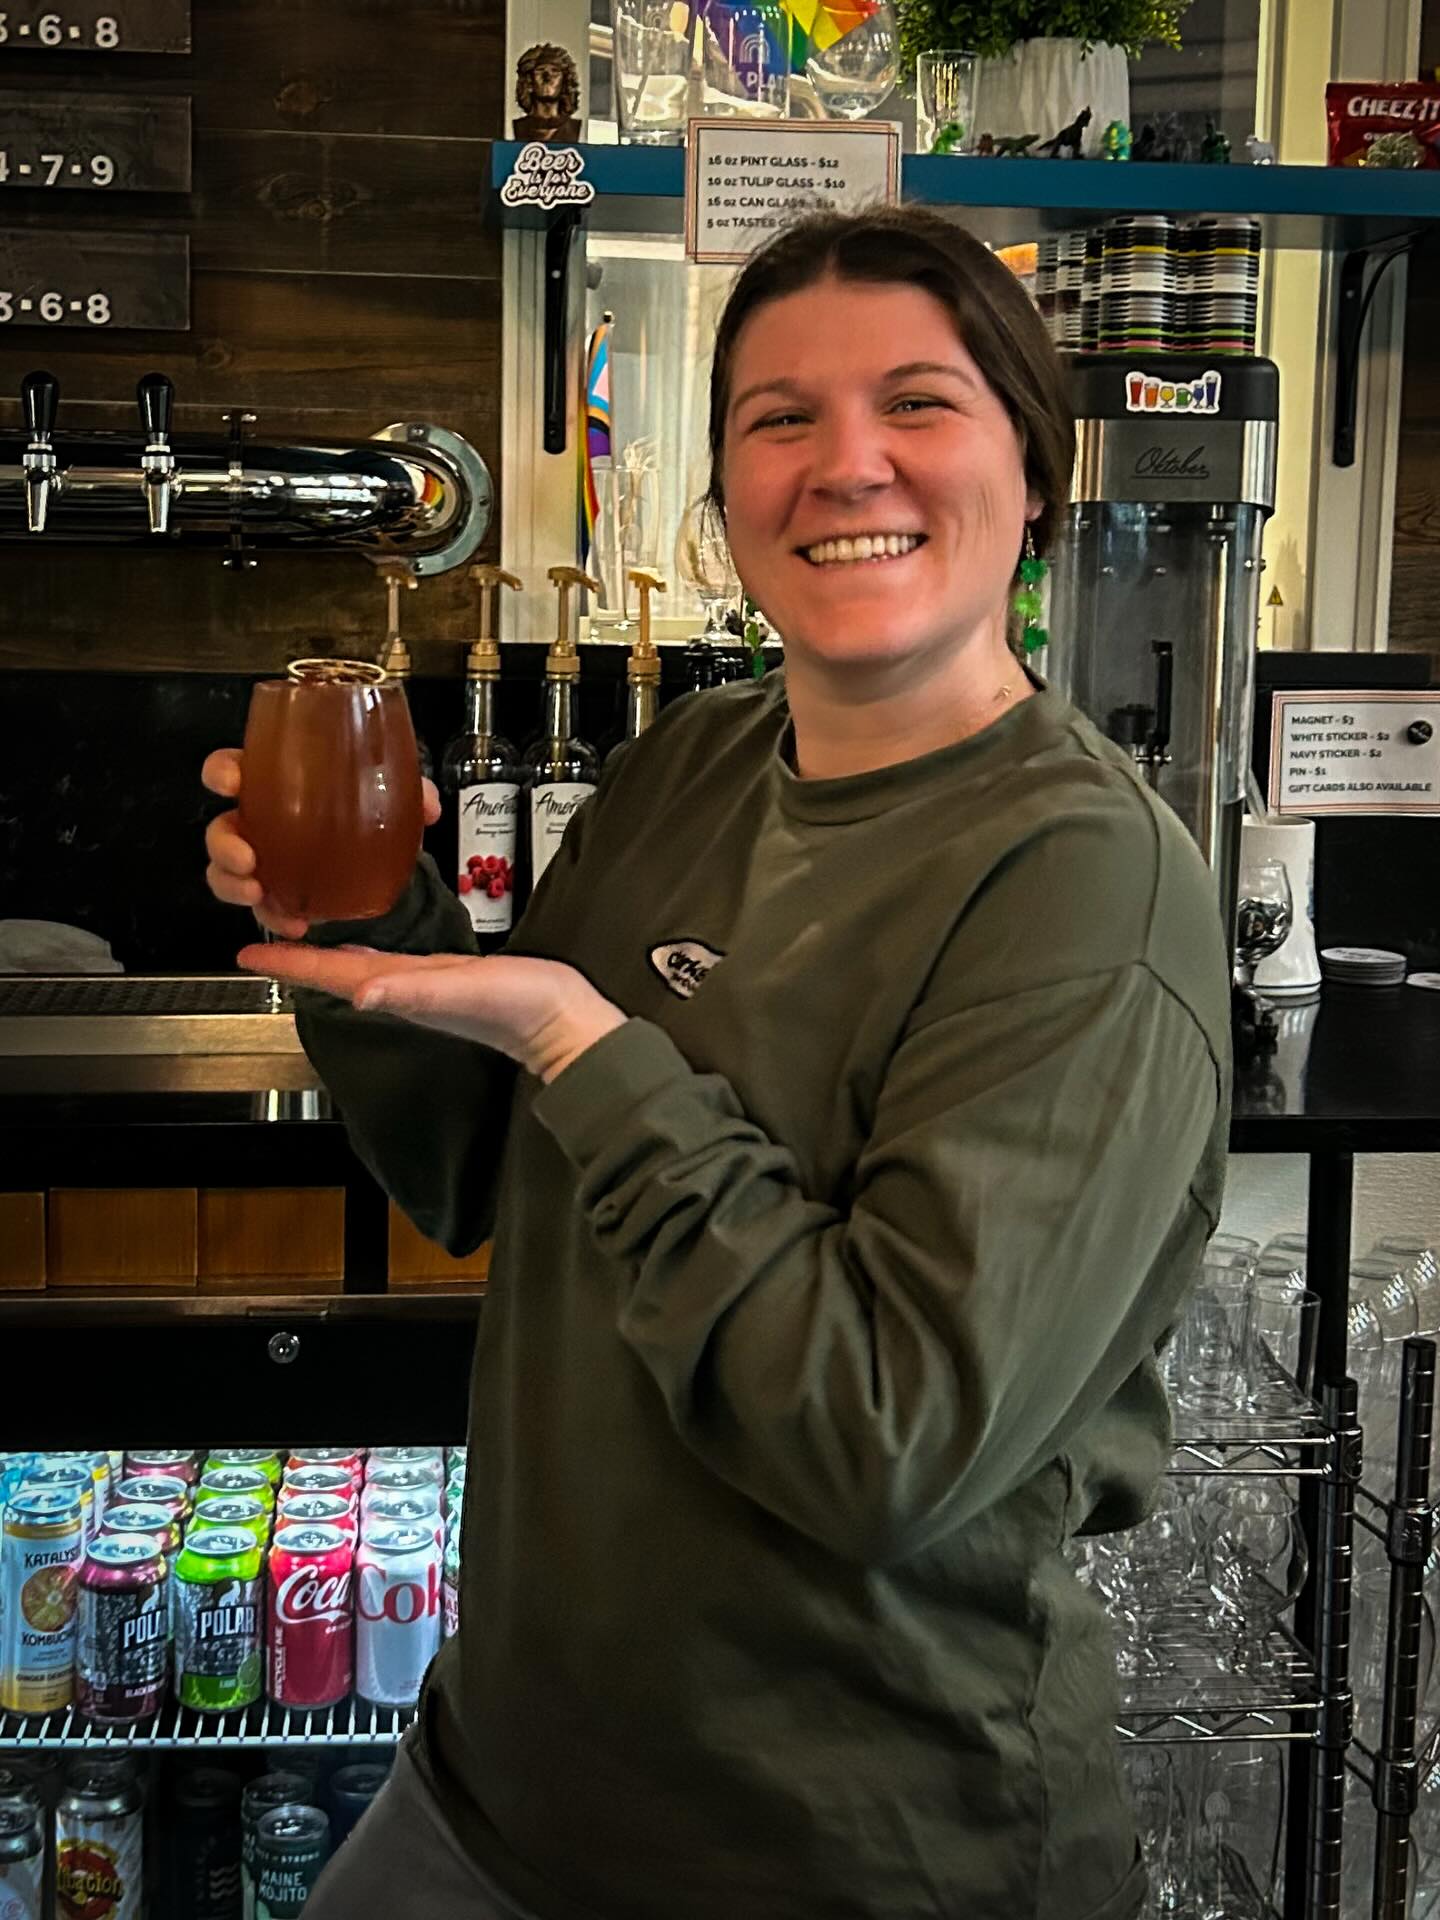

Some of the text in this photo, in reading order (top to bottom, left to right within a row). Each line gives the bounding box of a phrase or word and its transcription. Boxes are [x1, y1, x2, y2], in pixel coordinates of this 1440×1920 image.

[519, 146, 581, 173] Beer
[708, 155, 722, 165] 16
[725, 157, 737, 165] oz
[740, 156, 767, 166] PINT
[770, 157, 808, 167] GLASS
[818, 157, 839, 168] $12
[708, 177, 721, 186] 10
[724, 178, 737, 186] oz
[739, 177, 773, 187] TULIP
[776, 178, 814, 188] GLASS
[825, 178, 845, 189] $10
[506, 179, 592, 206] Everyone
[707, 197, 720, 207] 16
[724, 198, 736, 206] oz
[739, 198, 764, 207] CAN
[707, 218, 713, 228] 5
[717, 218, 729, 227] oz
[1292, 715, 1333, 725] MAGNET
[1291, 733, 1325, 742] WHITE
[1326, 732, 1368, 741] STICKER
[1290, 750, 1317, 759] NAVY
[1319, 749, 1360, 758] STICKER
[1289, 767, 1306, 776] PIN
[1289, 782, 1432, 793] GIFT CARDS ALSO AVAILABLE
[201, 1607, 255, 1639] POLAR
[261, 1868, 303, 1887] MAINE
[258, 1884, 308, 1902] MOJITO
